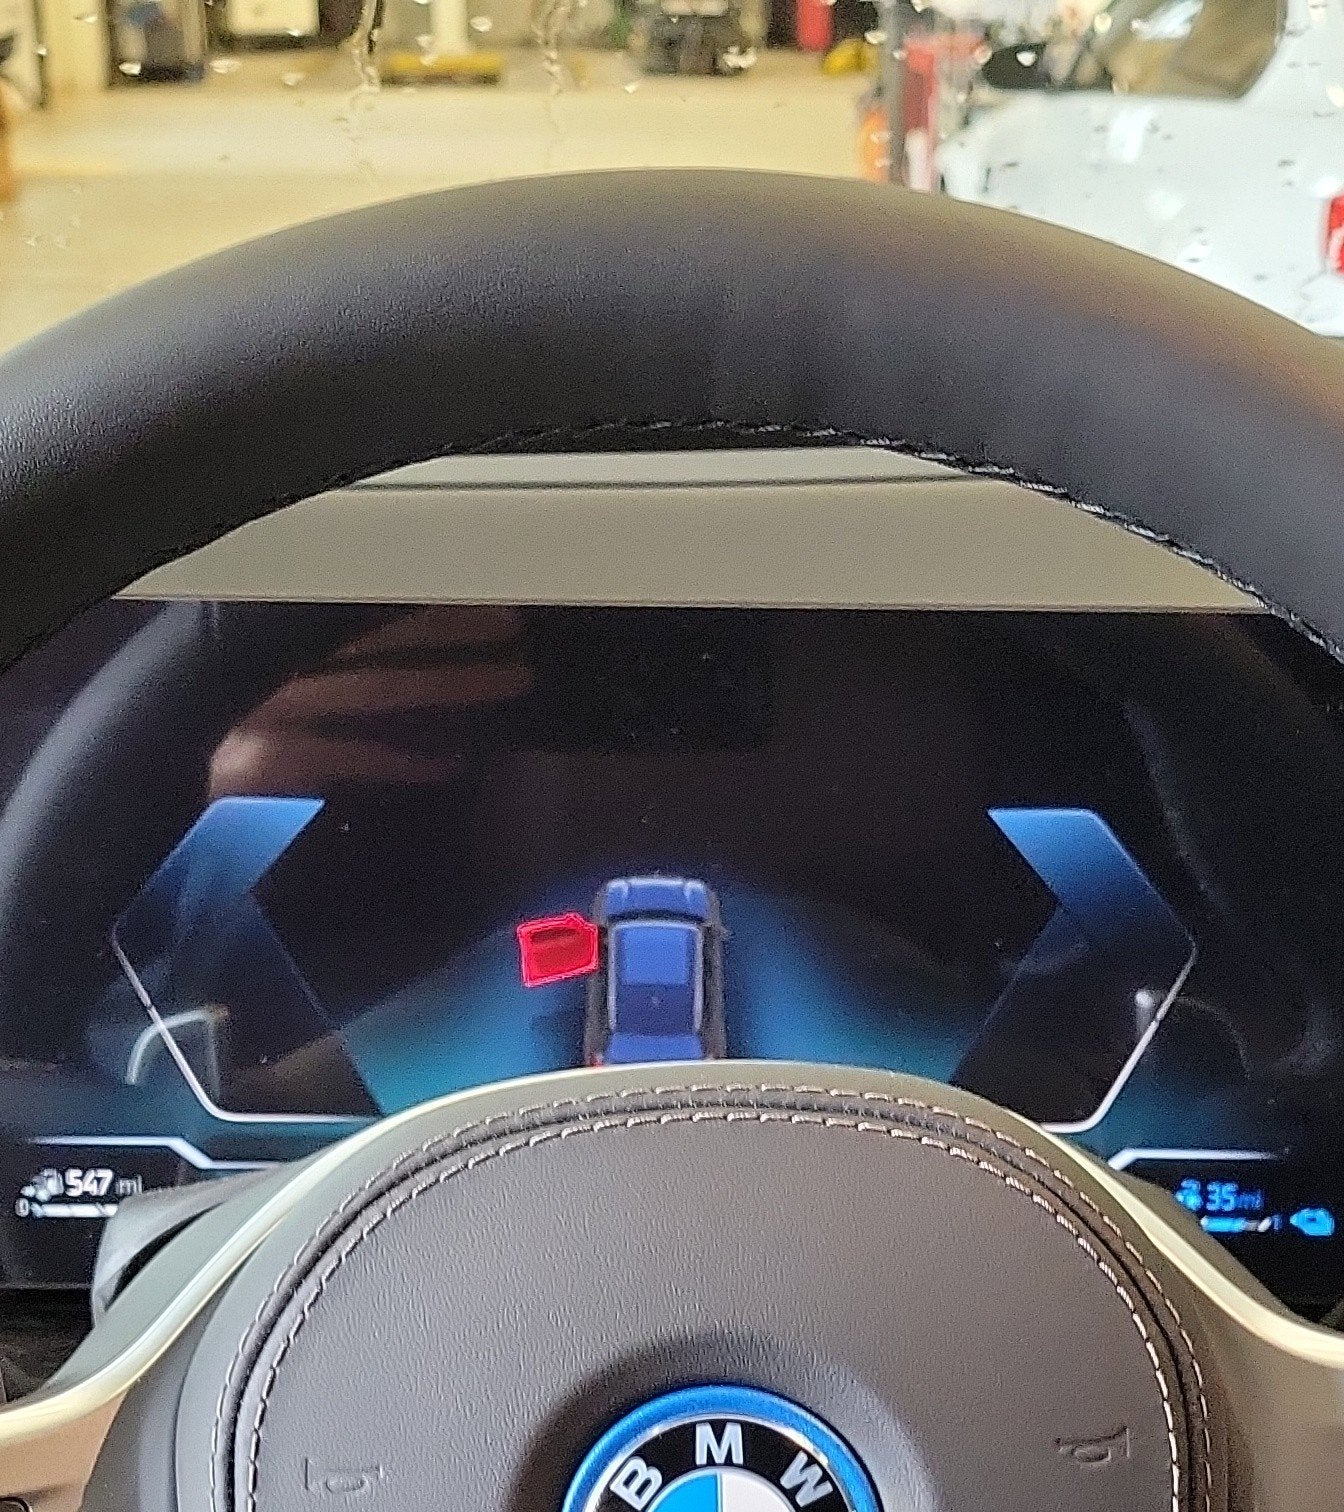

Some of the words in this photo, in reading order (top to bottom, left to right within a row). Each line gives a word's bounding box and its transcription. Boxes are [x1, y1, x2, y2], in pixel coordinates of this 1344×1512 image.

[64, 1168, 114, 1197] 547
[1206, 1180, 1239, 1212] 35
[609, 1421, 834, 1511] BMW
